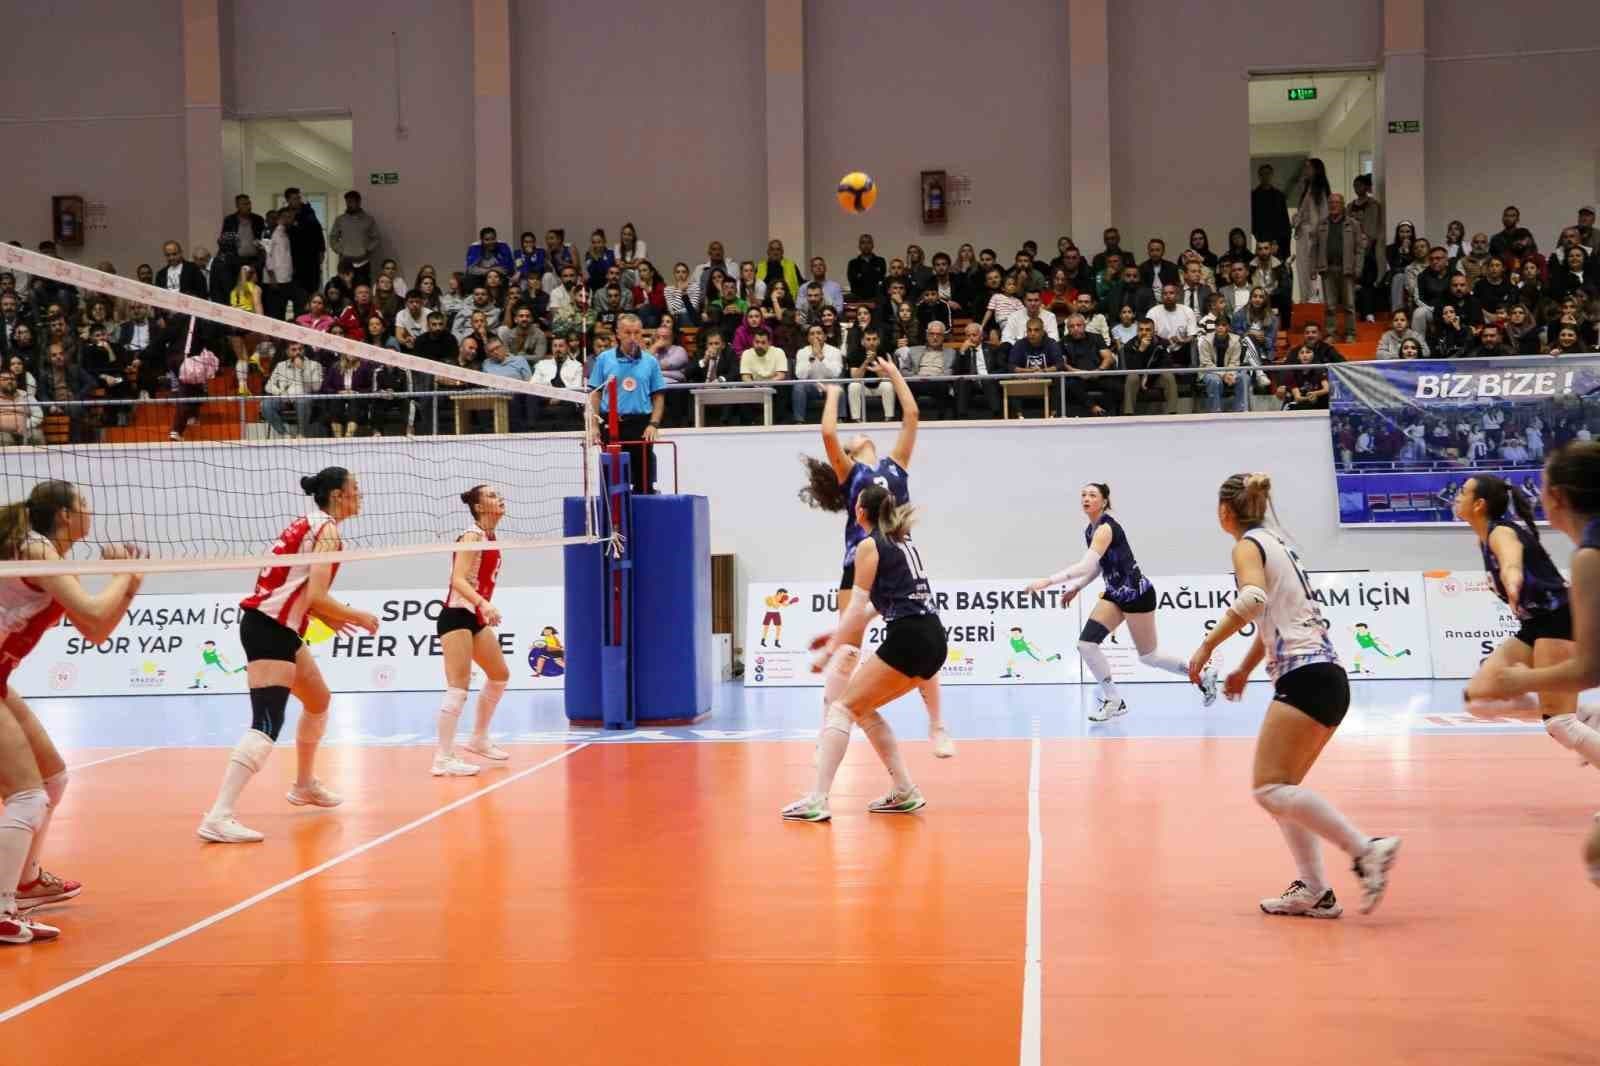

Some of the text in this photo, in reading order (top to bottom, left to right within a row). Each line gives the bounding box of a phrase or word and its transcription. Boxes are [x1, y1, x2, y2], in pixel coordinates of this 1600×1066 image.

[1359, 582, 1410, 611] İÇİN
[127, 608, 205, 630] YAŞAM
[381, 600, 445, 622] SPO
[943, 621, 994, 642] YSERİ
[66, 636, 183, 655] SPOR YAP
[332, 634, 397, 657] HER
